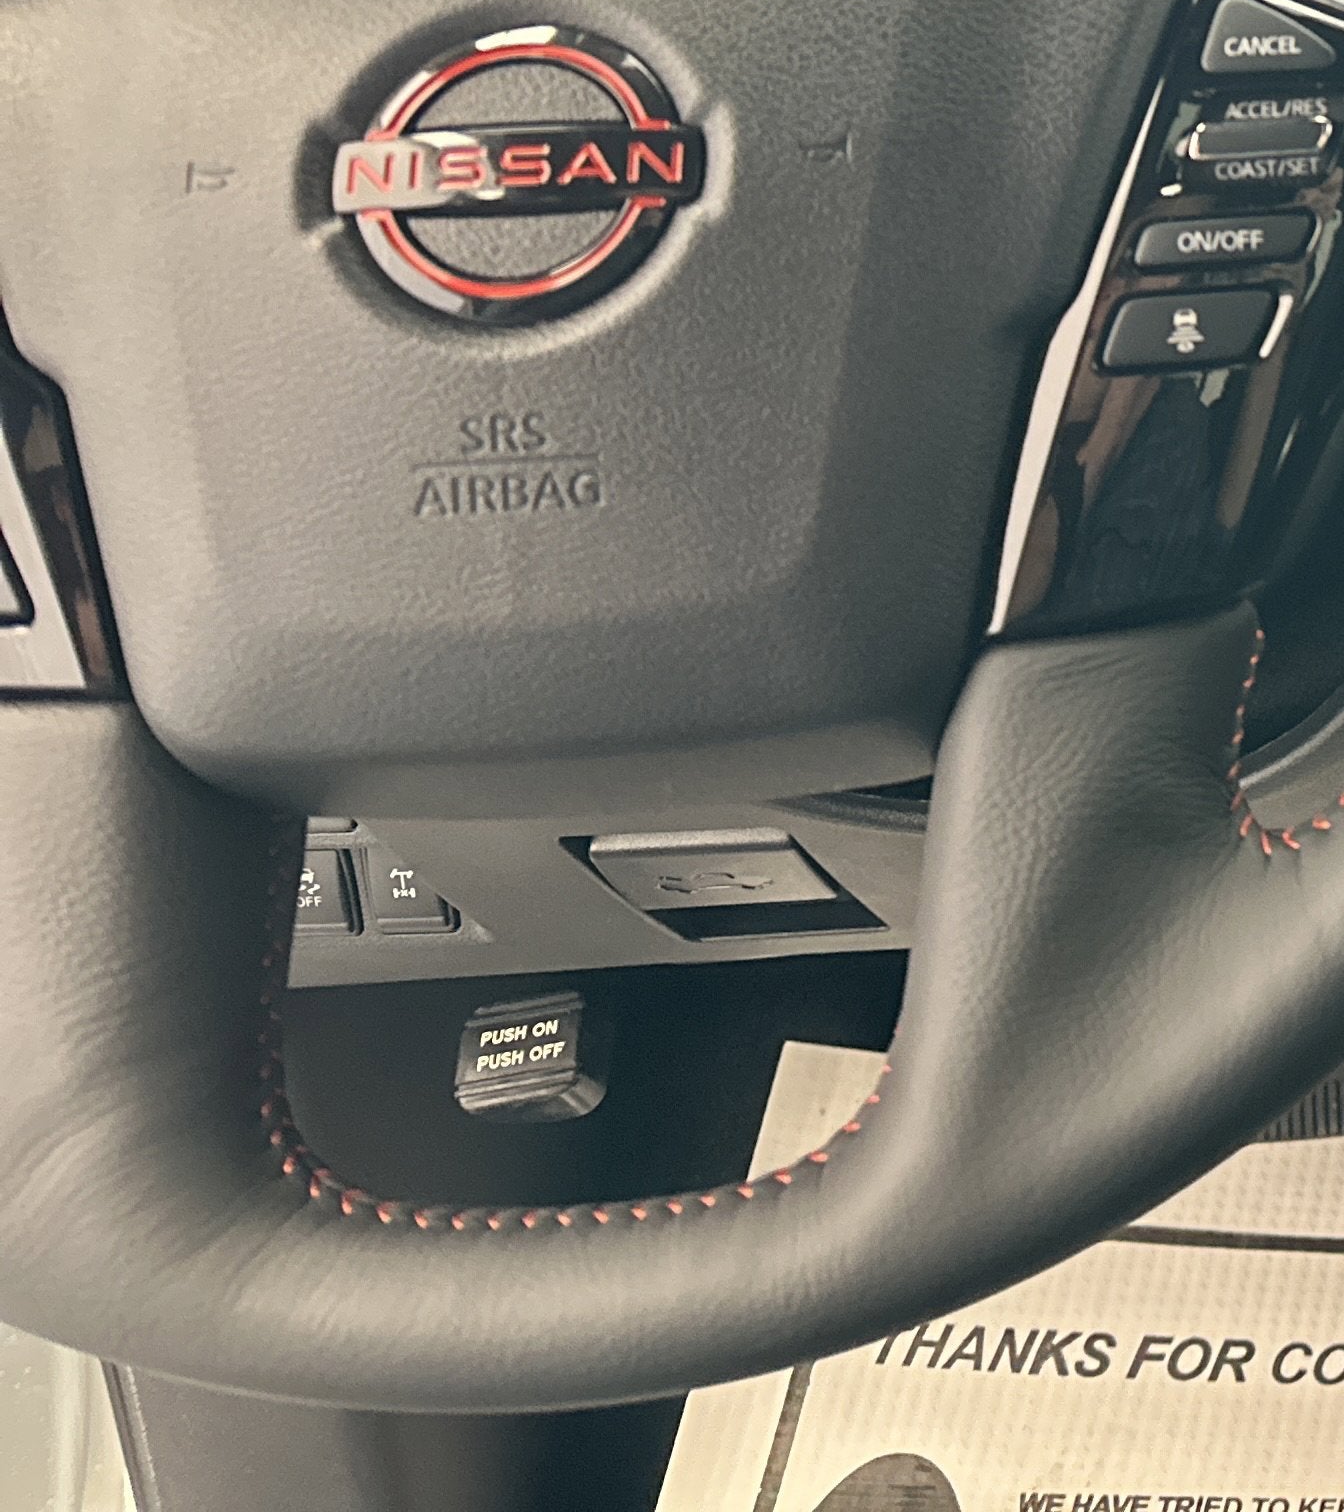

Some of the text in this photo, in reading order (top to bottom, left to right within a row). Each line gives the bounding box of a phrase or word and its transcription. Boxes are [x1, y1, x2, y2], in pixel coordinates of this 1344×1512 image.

[1224, 36, 1302, 56] CANCEL
[1225, 99, 1328, 121] ACCEL/RES
[346, 140, 686, 196] NISSAN
[1215, 157, 1321, 180] COAST/SET
[1177, 229, 1264, 252] ON/OFF
[460, 411, 546, 454] SRS
[412, 470, 602, 517] AIRBAG
[480, 1019, 559, 1047] PUSH ON
[477, 1041, 565, 1072] PUSH OFF
[1126, 1335, 1256, 1384] FOR
[1019, 1492, 1066, 1512] WE
[1071, 1494, 1150, 1512] HAVE
[1158, 1496, 1243, 1512] TRIED
[1251, 1497, 1291, 1512] TO
